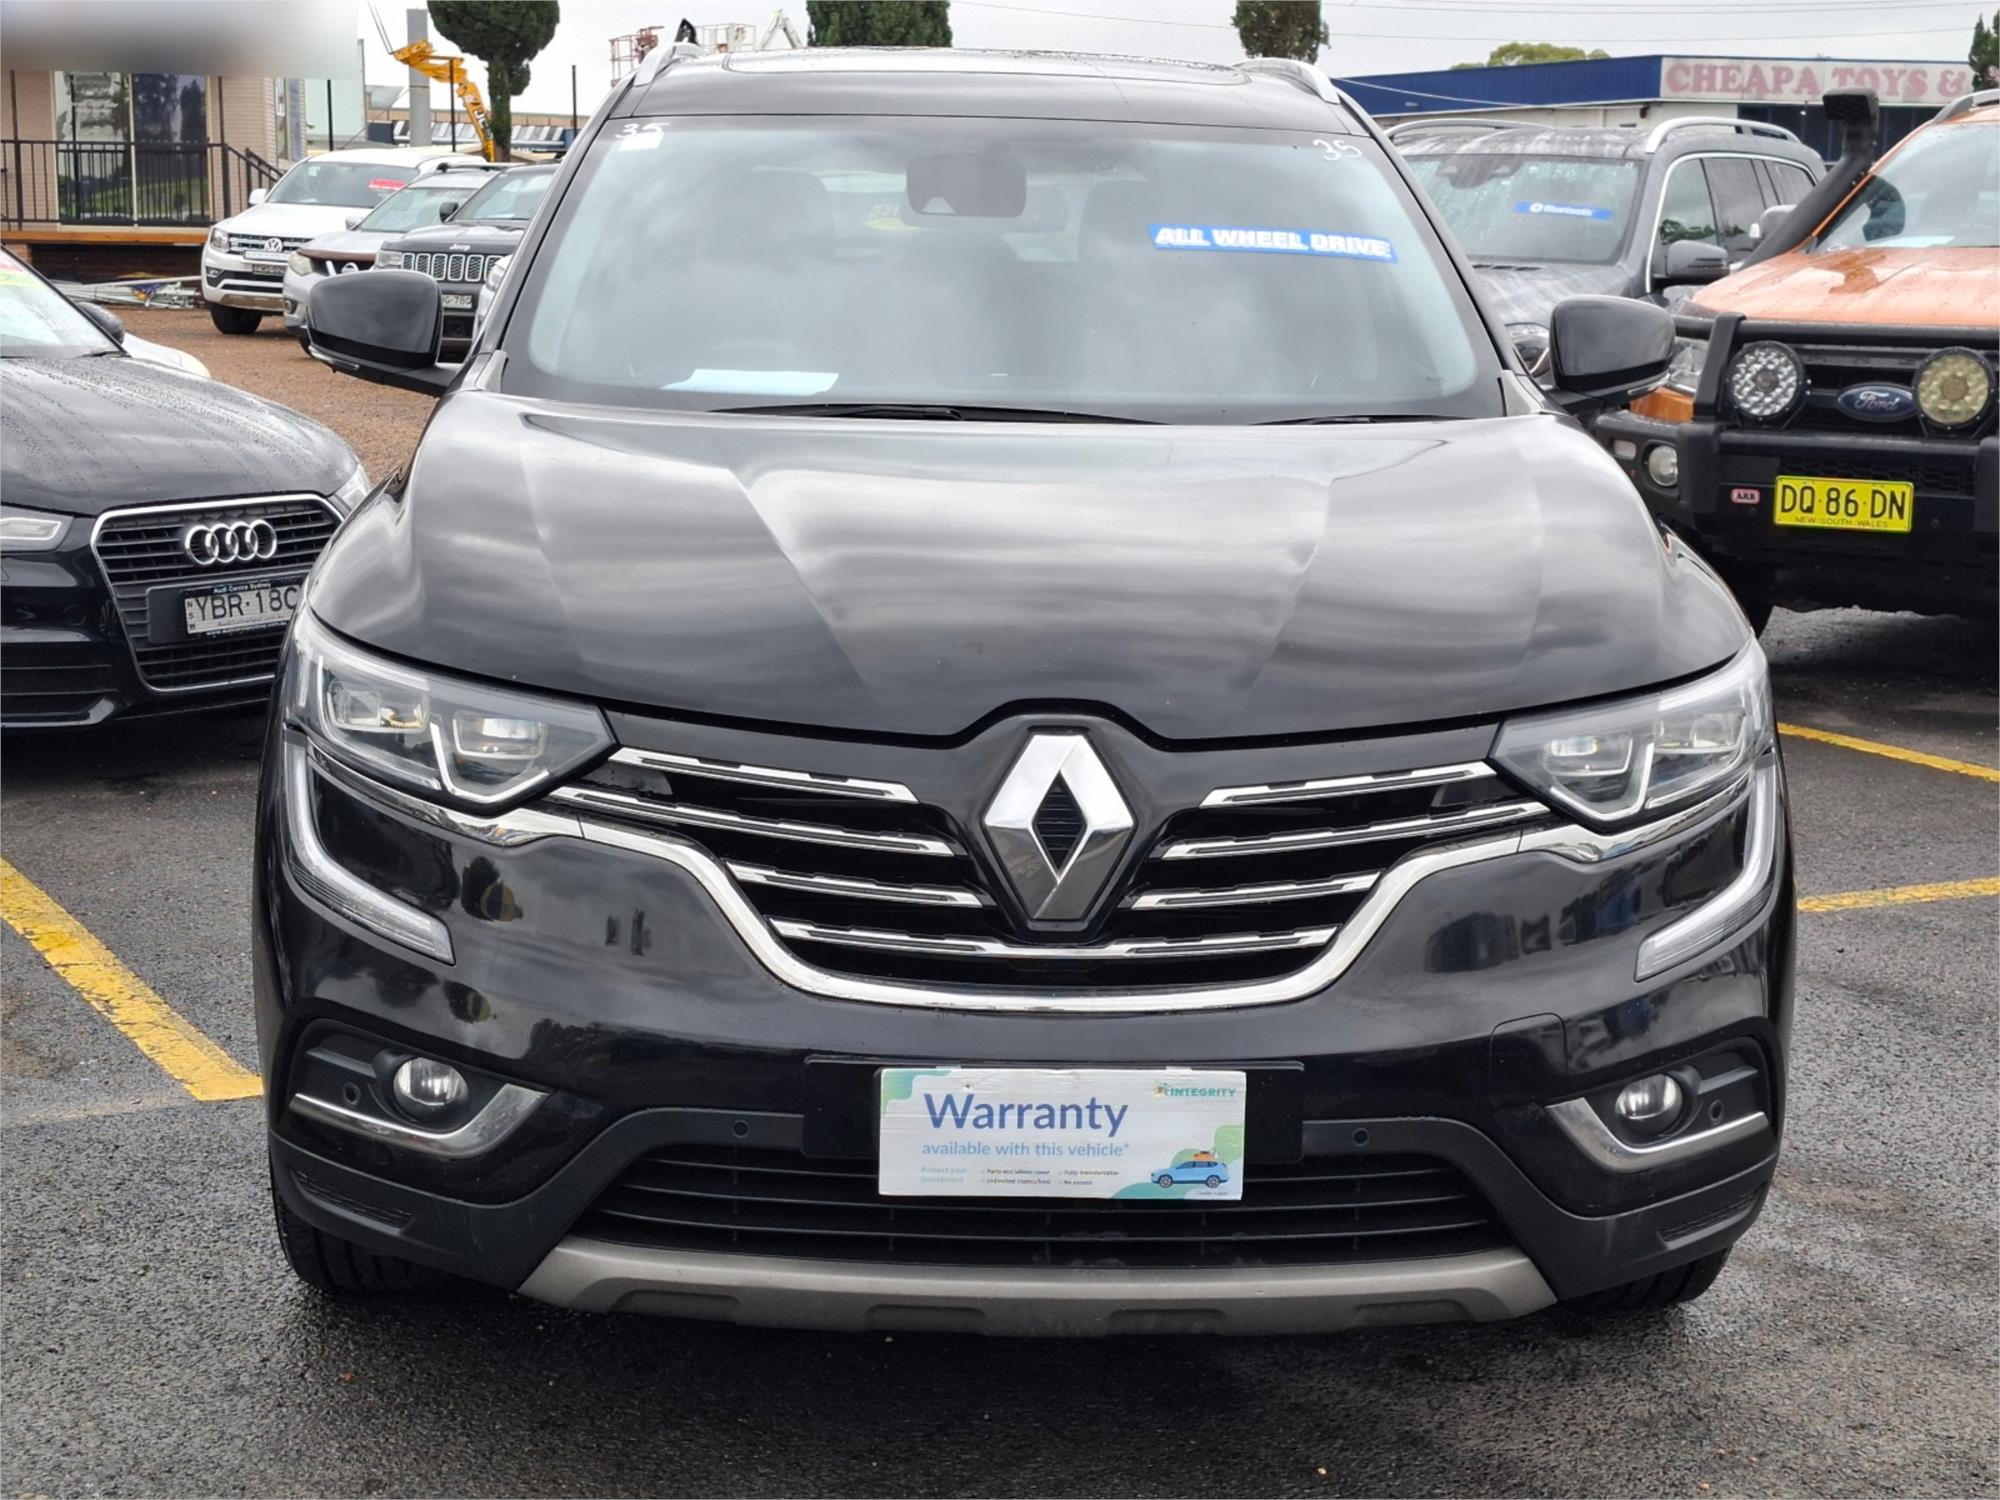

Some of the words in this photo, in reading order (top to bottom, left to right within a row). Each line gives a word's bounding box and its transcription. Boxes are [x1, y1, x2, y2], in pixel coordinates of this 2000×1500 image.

[1665, 62, 1822, 96] CHEAPA
[1832, 66, 1928, 97] TOYS
[1937, 70, 1967, 98] &
[1313, 139, 1363, 161] 35
[450, 244, 471, 252] Jeep
[1154, 227, 1210, 246] ALL
[1211, 229, 1309, 251] WHEEL
[1310, 233, 1393, 259] DRIVE
[1854, 390, 1901, 411] Ford
[1794, 516, 1816, 524] NEW
[1821, 517, 1852, 526] SOUTH
[1856, 519, 1889, 528] WALES
[1170, 1087, 1237, 1097] INTEGRITY
[924, 1093, 1129, 1138] Warranty
[922, 1141, 991, 1155] available
[994, 1142, 1030, 1155] with
[1035, 1142, 1063, 1156] this
